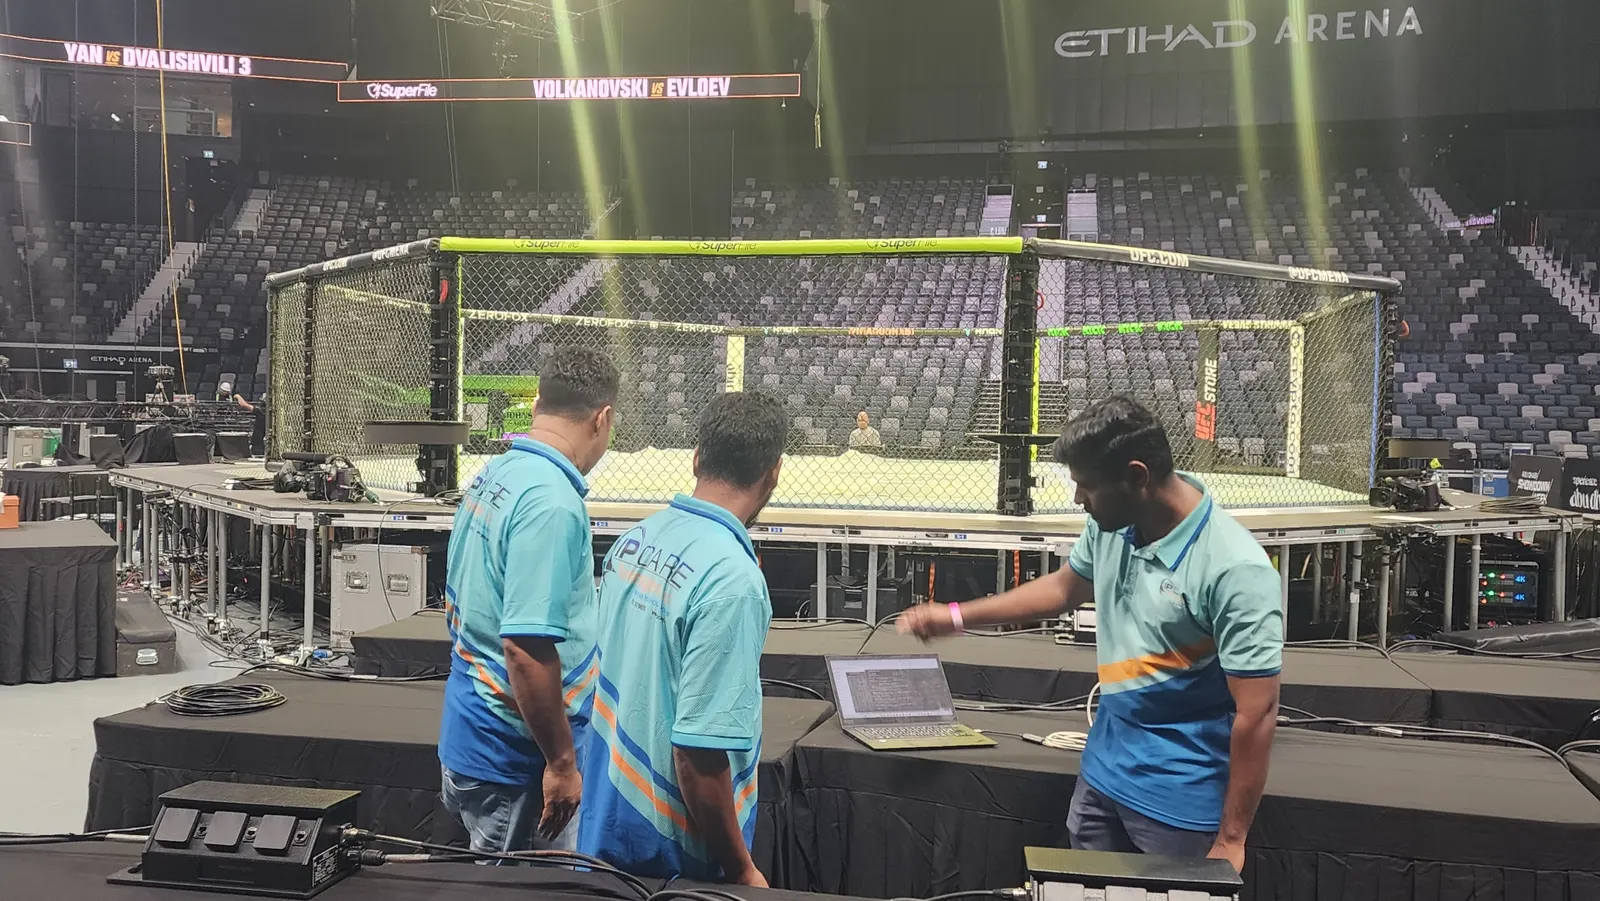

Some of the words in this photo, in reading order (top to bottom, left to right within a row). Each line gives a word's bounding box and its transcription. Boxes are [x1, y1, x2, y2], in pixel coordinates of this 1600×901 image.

[1054, 19, 1257, 58] ETIHAD
[1273, 6, 1423, 45] ARENA
[63, 42, 102, 64] YAN
[105, 49, 121, 63] VS
[123, 46, 235, 74] DVALISHVILI
[239, 57, 251, 75] 3
[380, 83, 438, 99] SuperFile
[532, 78, 649, 98] VOLKANOVSKI
[651, 81, 664, 97] VS
[667, 77, 731, 97] EVLOEV
[1130, 249, 1189, 268] UFC.COM
[1288, 266, 1350, 284] @UFCMENA
[468, 310, 528, 322] ZEROFOX
[574, 317, 631, 329] ZEROFOX
[674, 323, 725, 334] ZEROFOX
[90, 355, 126, 363] ETIHAD
[1204, 357, 1218, 403] STORE
[1194, 400, 1217, 442] UFC
[1518, 478, 1551, 492] SHOWDOWN
[1569, 487, 1589, 509] abu
[1514, 575, 1526, 583] 4K
[1514, 593, 1525, 601] 4K
